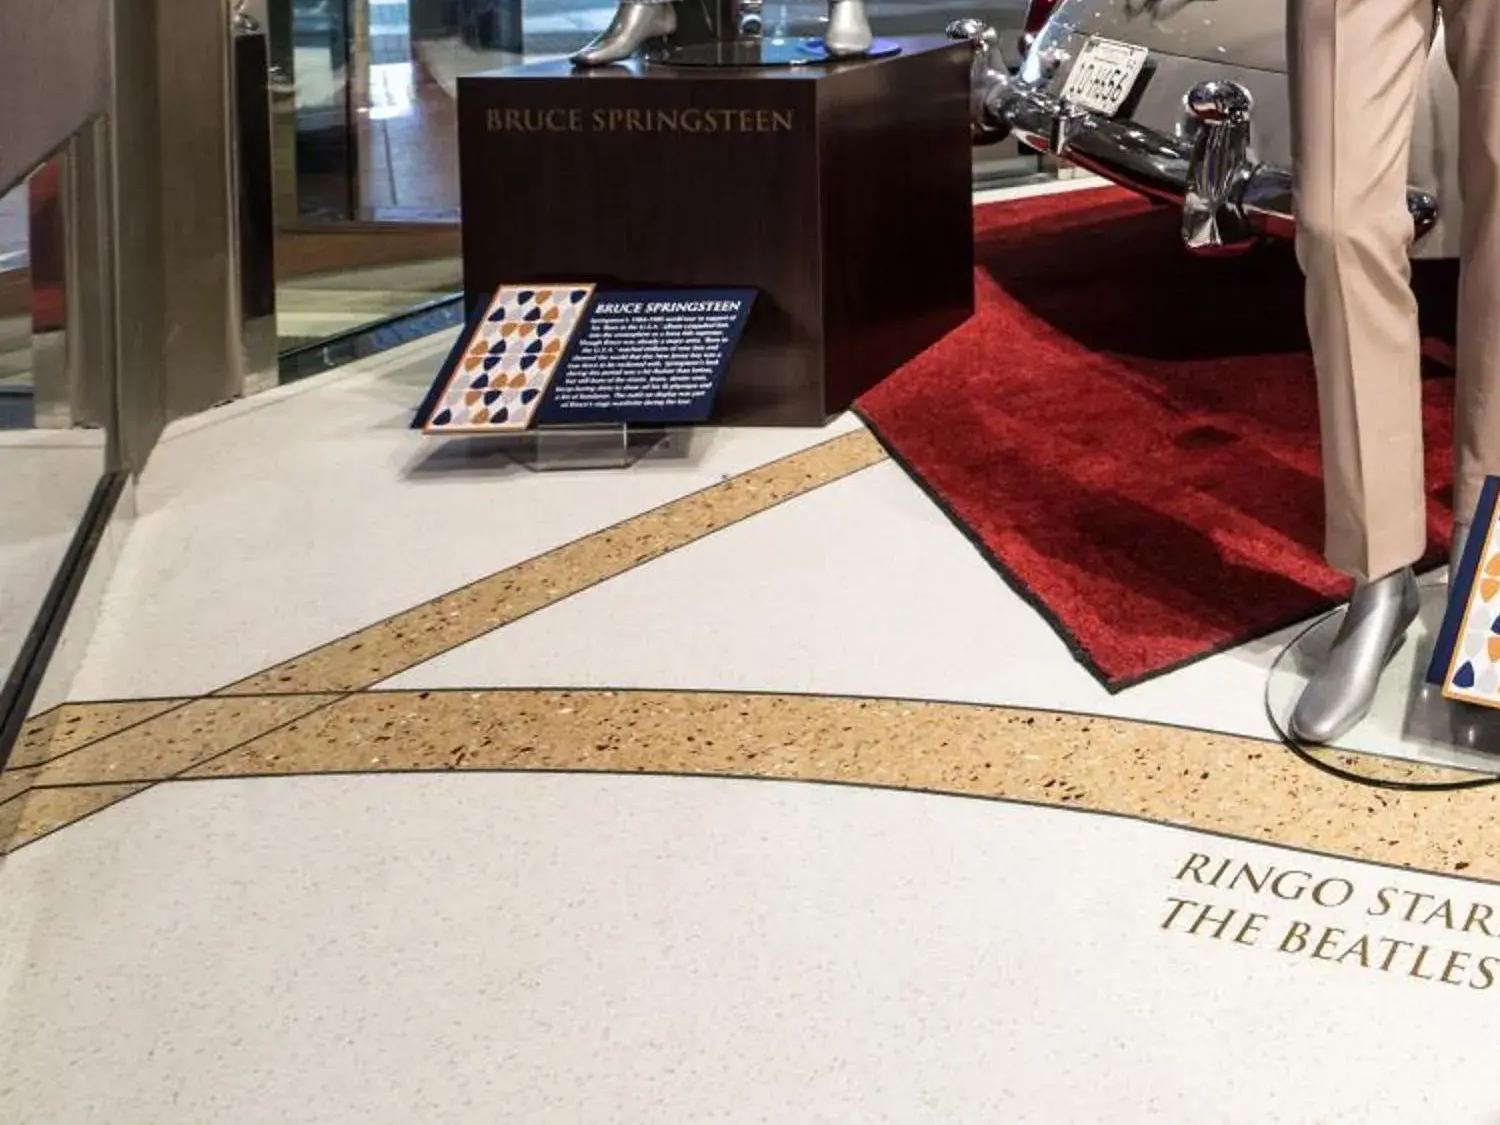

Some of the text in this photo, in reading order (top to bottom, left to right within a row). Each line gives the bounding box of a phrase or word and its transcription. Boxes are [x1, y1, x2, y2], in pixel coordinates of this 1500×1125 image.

[486, 108, 794, 132] BRUCE SPRINGSTEEN
[595, 300, 742, 314] BRUCE SPRINGSTEEN
[1174, 852, 1355, 907] RINGO
[1160, 897, 1268, 946] THE
